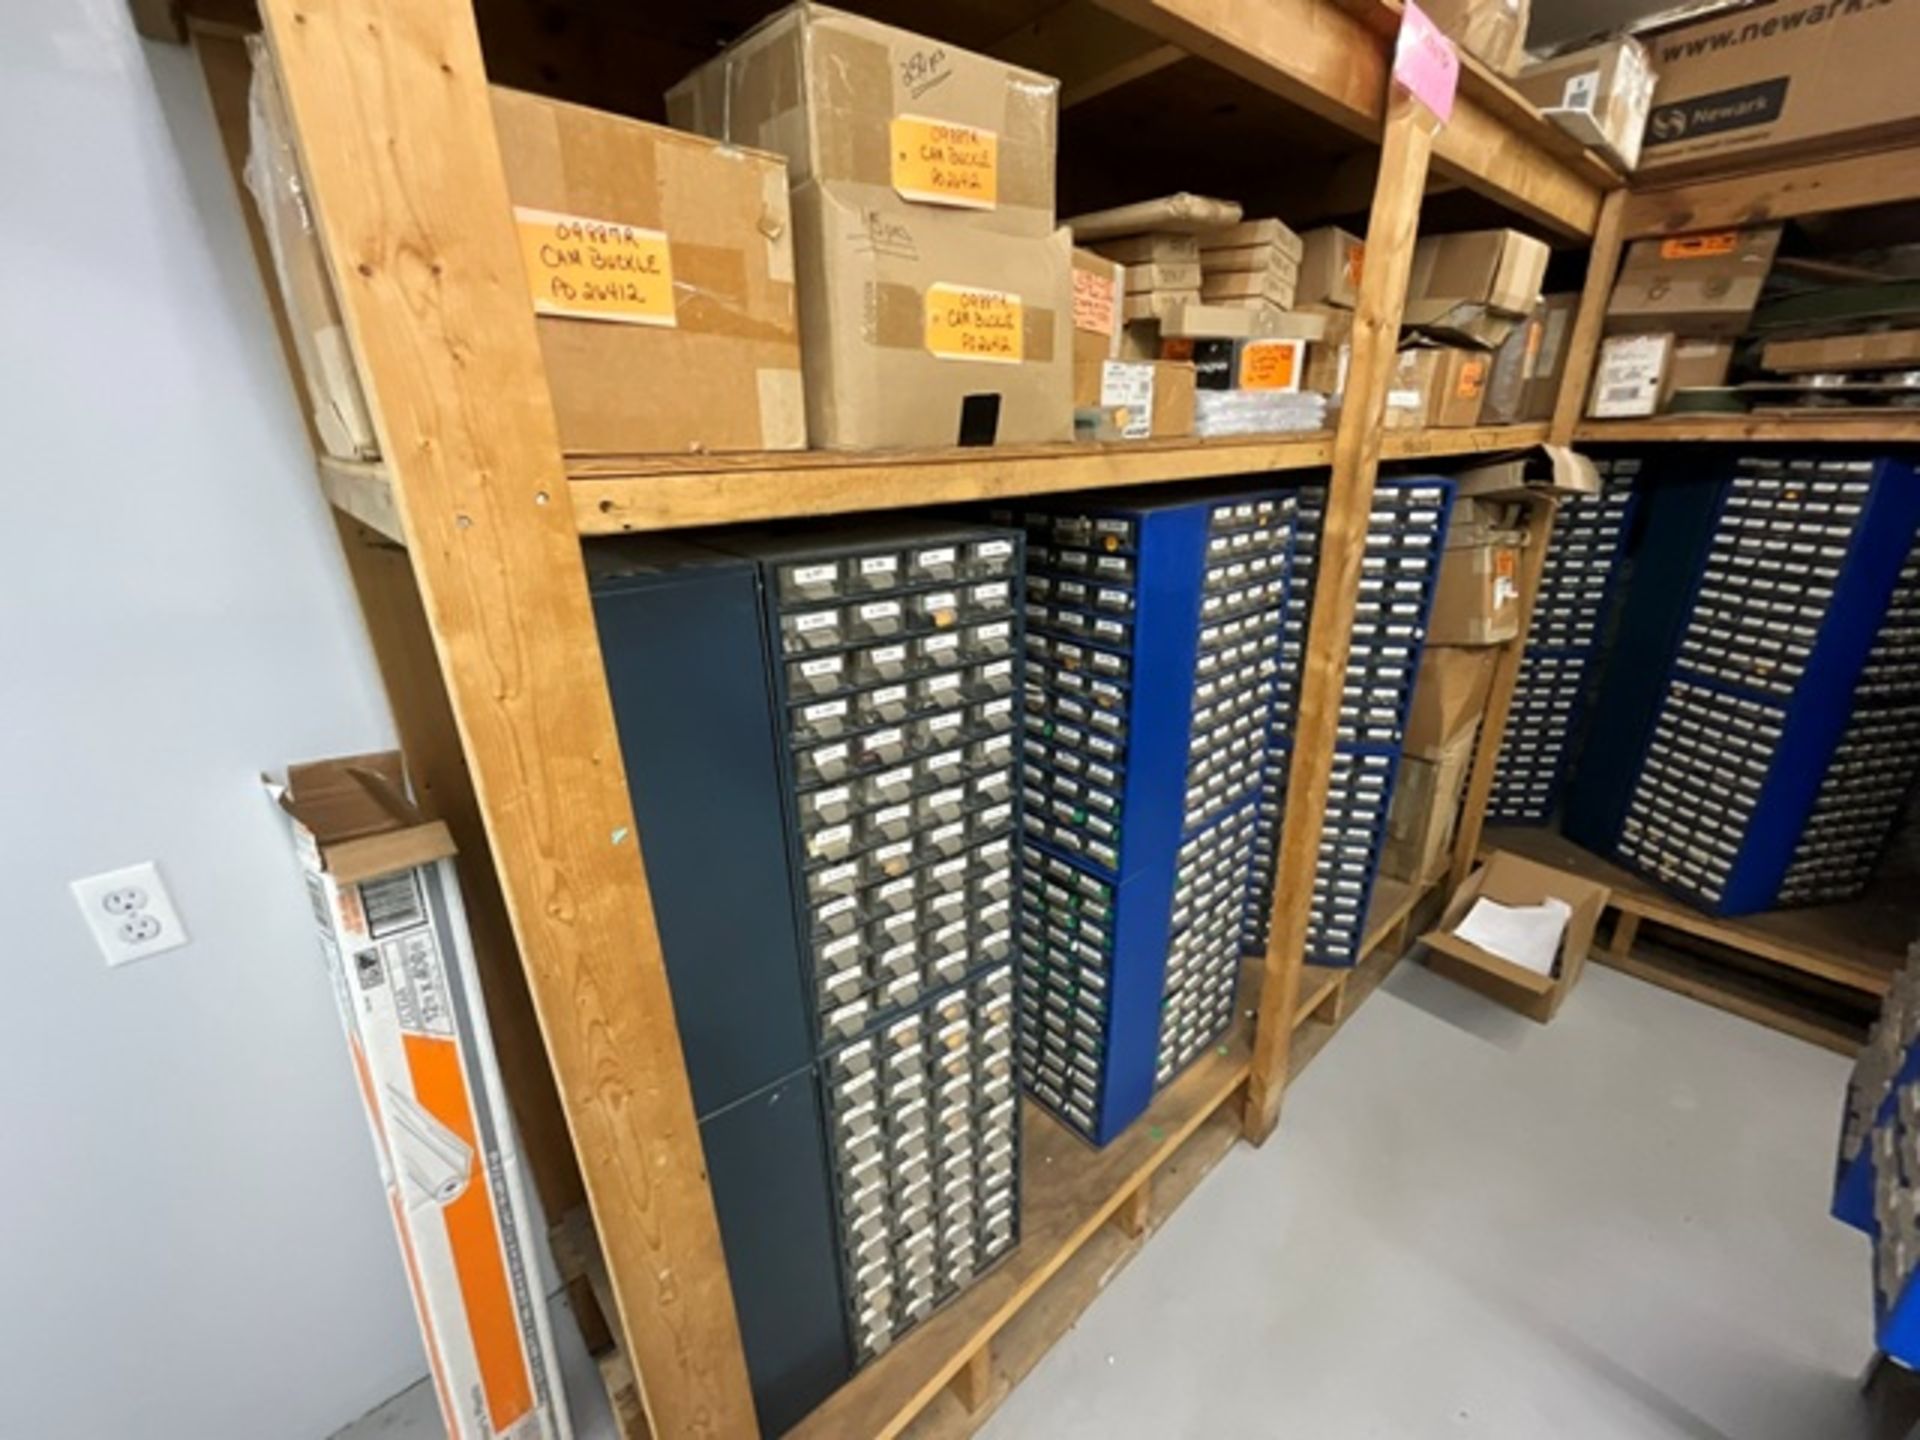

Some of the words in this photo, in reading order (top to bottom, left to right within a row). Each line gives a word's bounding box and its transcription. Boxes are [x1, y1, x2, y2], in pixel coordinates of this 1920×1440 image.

[1692, 96, 1768, 124] Newark
[539, 243, 582, 268] CAM
[587, 246, 662, 275] BUCKLE
